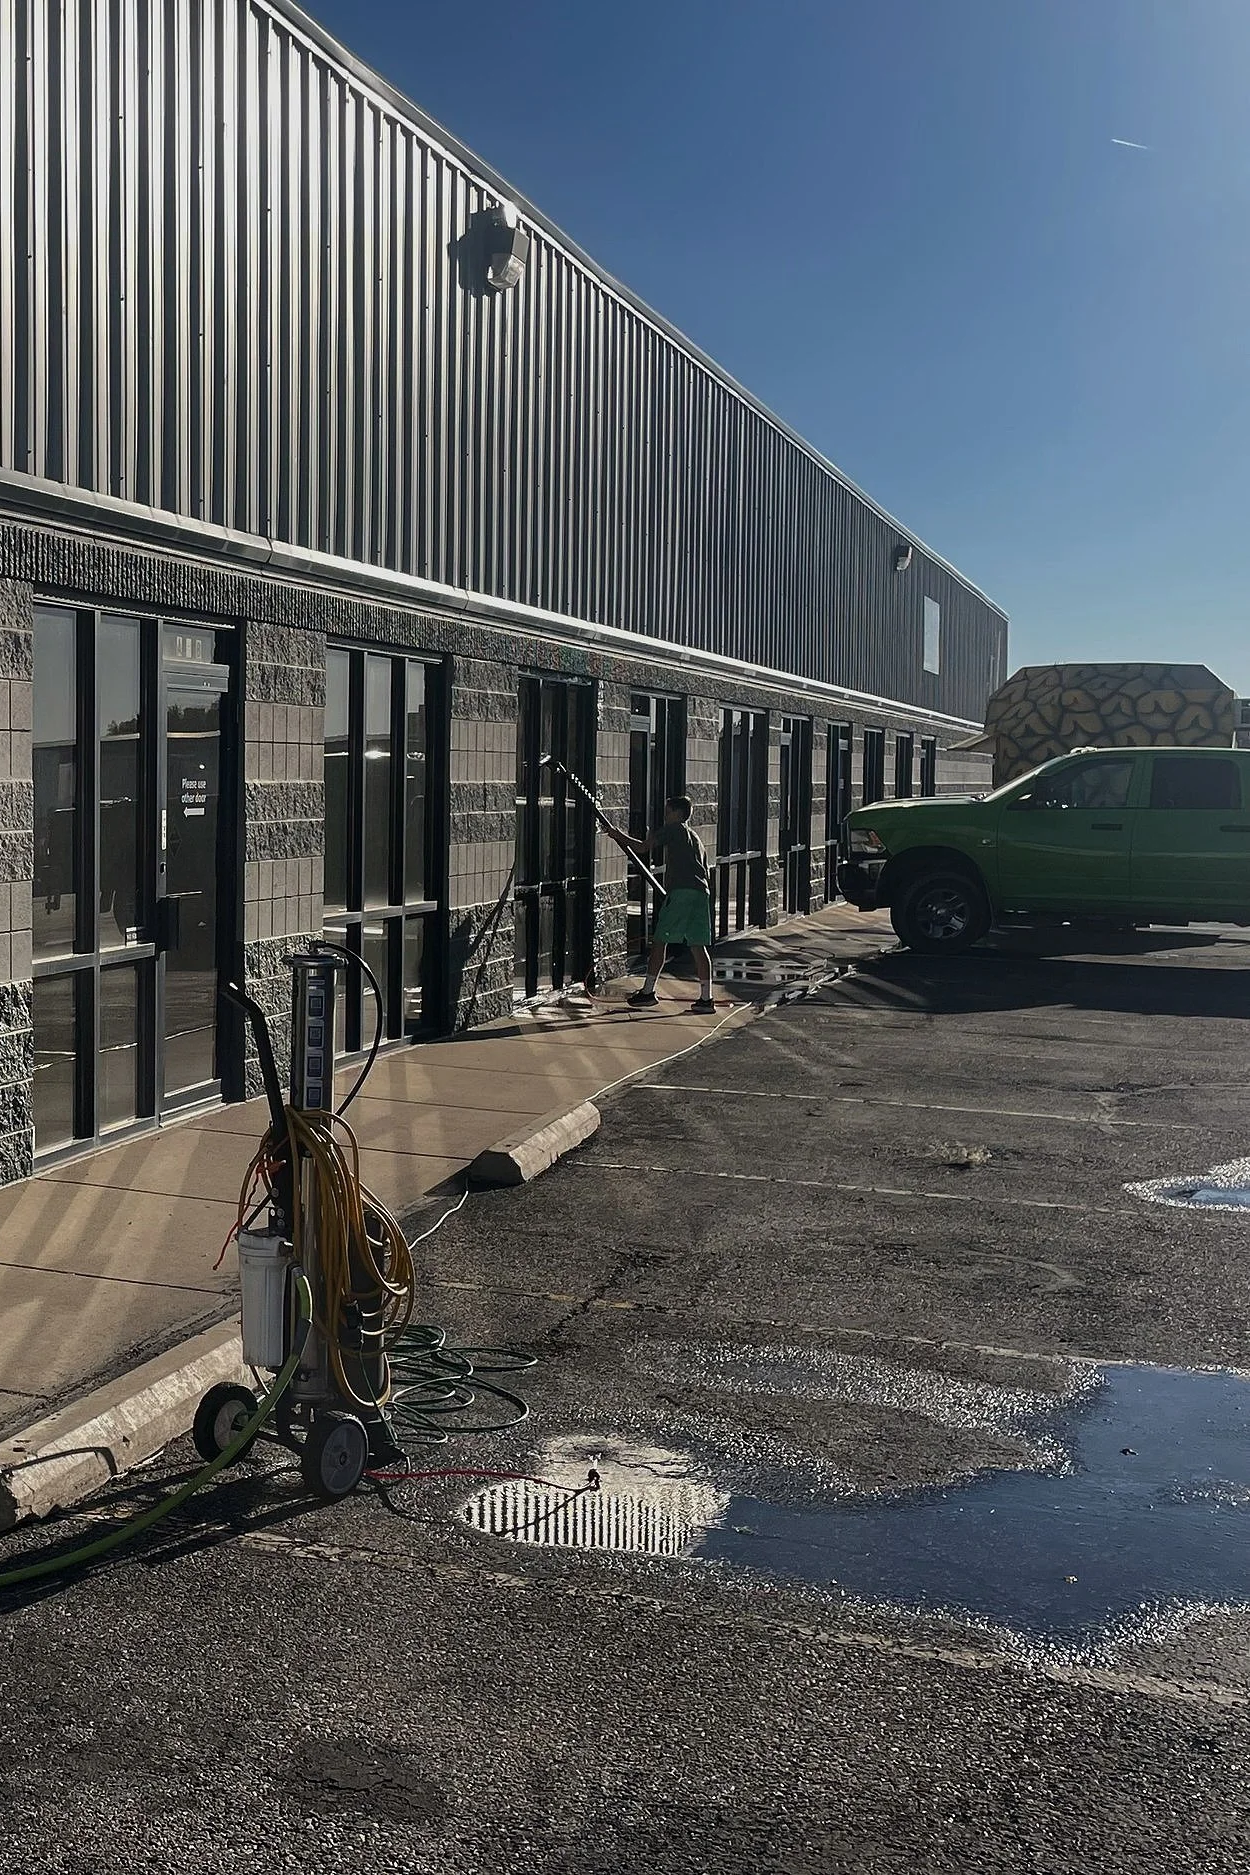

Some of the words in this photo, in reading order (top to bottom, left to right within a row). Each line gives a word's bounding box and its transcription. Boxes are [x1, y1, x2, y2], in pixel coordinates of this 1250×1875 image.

[182, 778, 197, 789] Please
[197, 780, 207, 789] use
[181, 792, 195, 803] other
[195, 791, 207, 803] door
